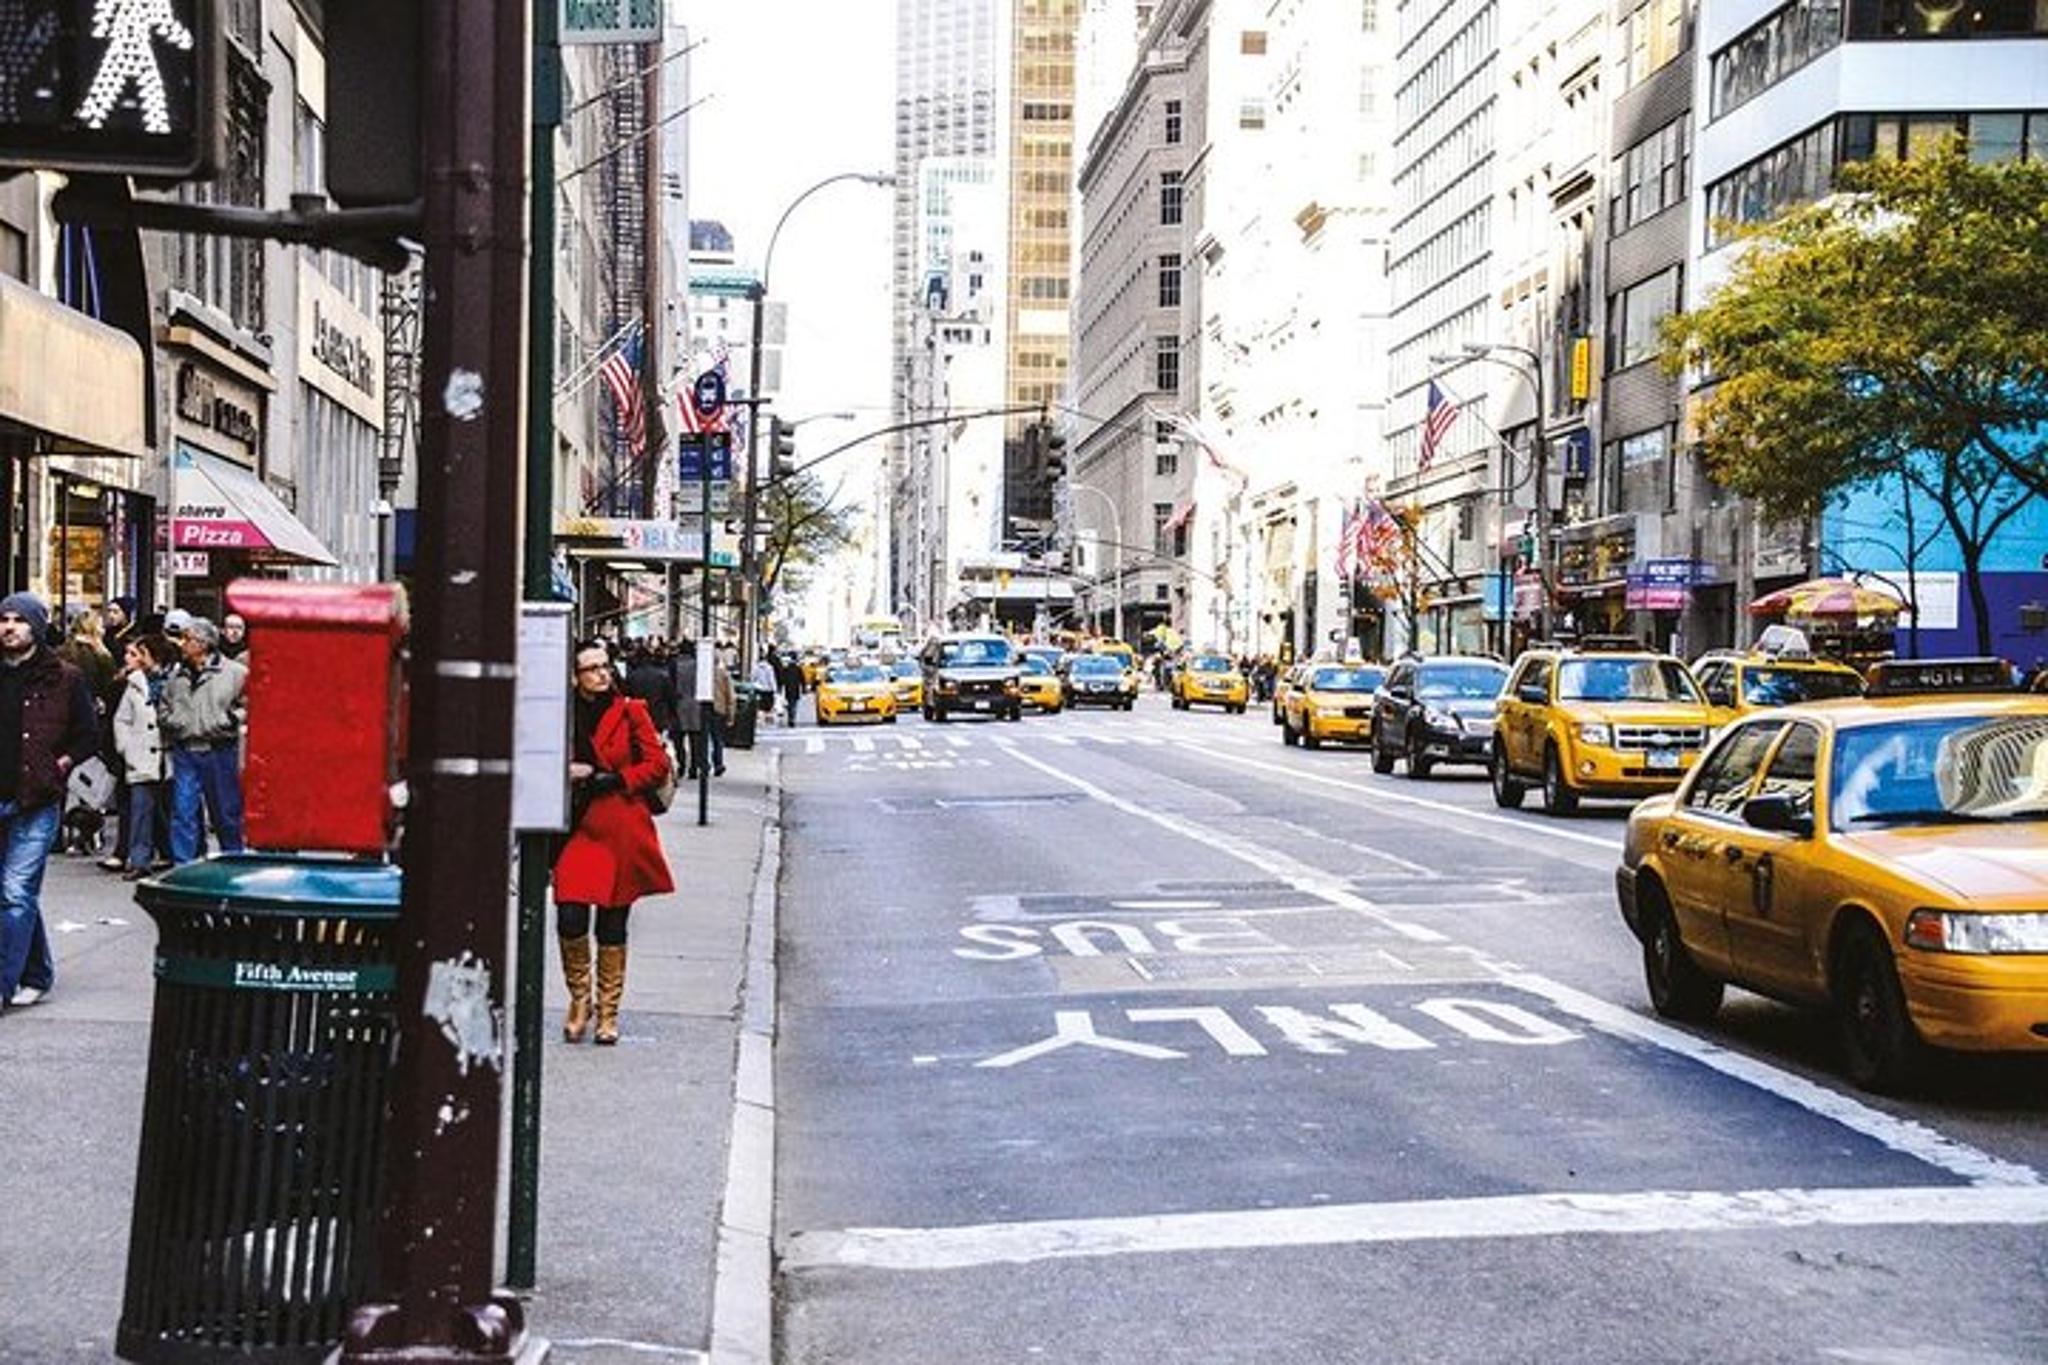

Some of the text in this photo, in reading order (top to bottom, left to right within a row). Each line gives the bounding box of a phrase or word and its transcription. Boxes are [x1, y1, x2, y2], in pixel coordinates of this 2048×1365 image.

[182, 525, 243, 545] Pizza
[1919, 669, 1965, 686] 4G14
[235, 961, 358, 982] Fifth Avenue
[972, 997, 1588, 1069] ONLY
